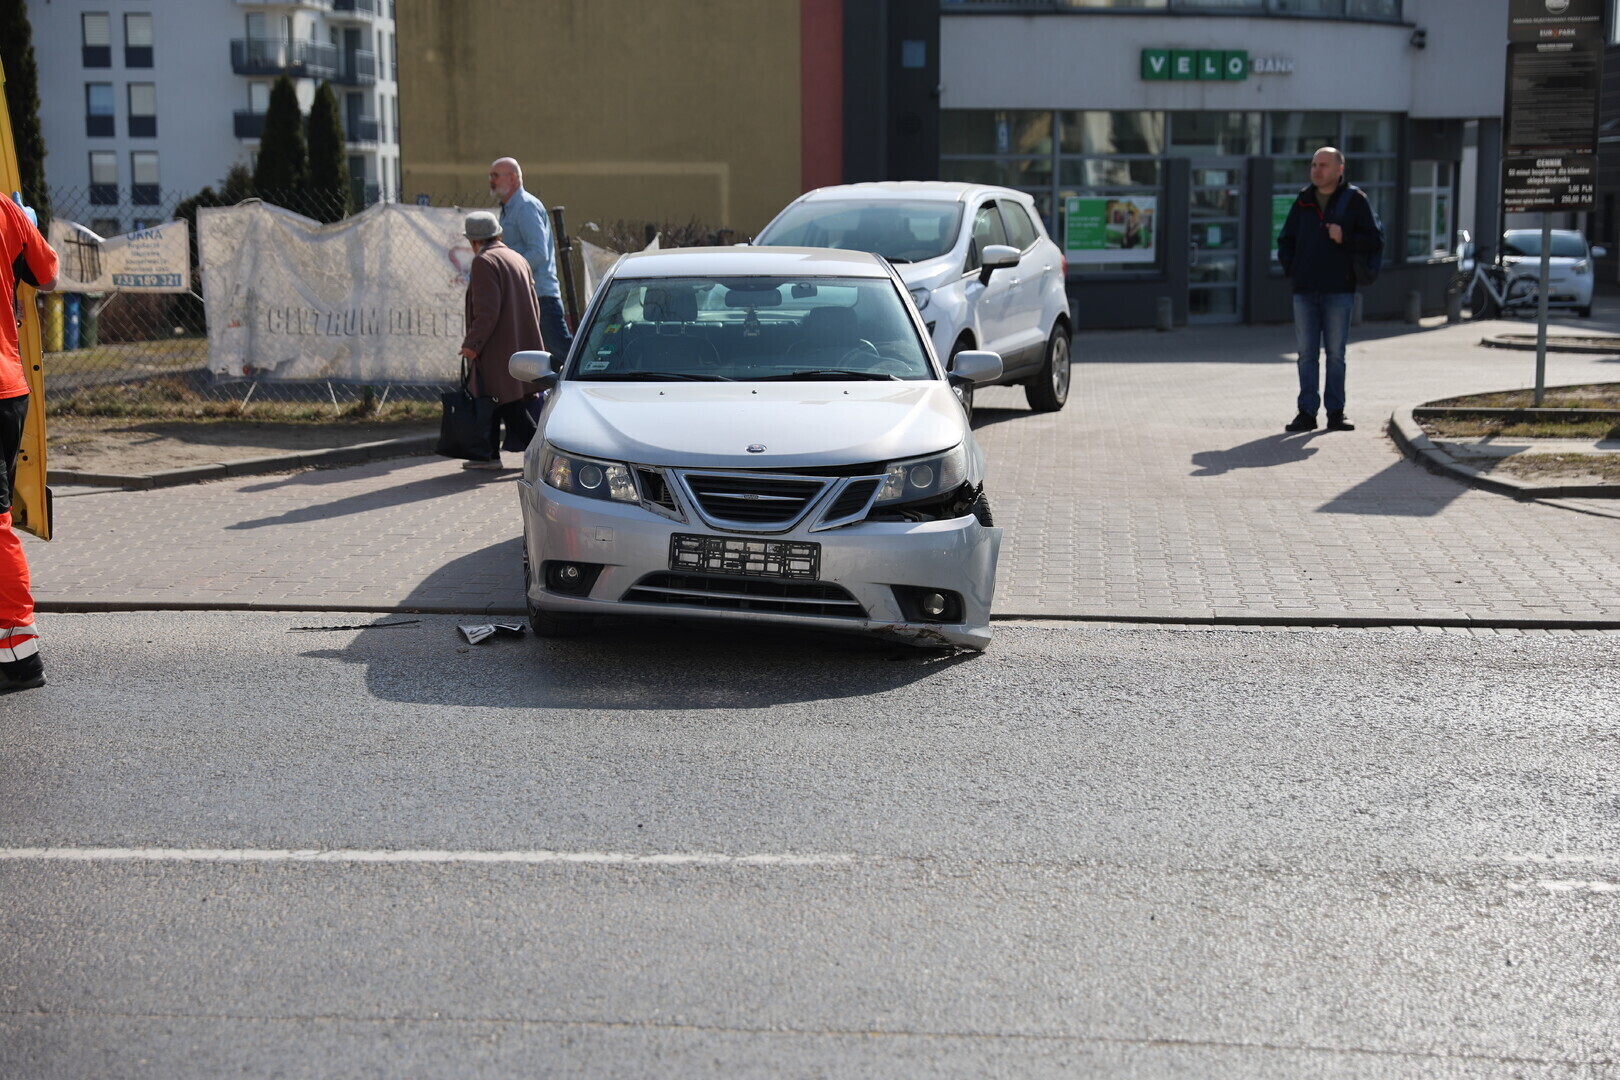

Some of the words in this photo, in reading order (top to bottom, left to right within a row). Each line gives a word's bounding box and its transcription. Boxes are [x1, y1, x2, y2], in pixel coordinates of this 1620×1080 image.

[1150, 57, 1243, 74] VELO
[1254, 57, 1295, 73] BANK
[1581, 184, 1593, 193] PLN
[1581, 194, 1593, 203] PLN
[137, 275, 157, 286] 189
[160, 275, 179, 285] 321
[268, 306, 381, 337] CENTRUM
